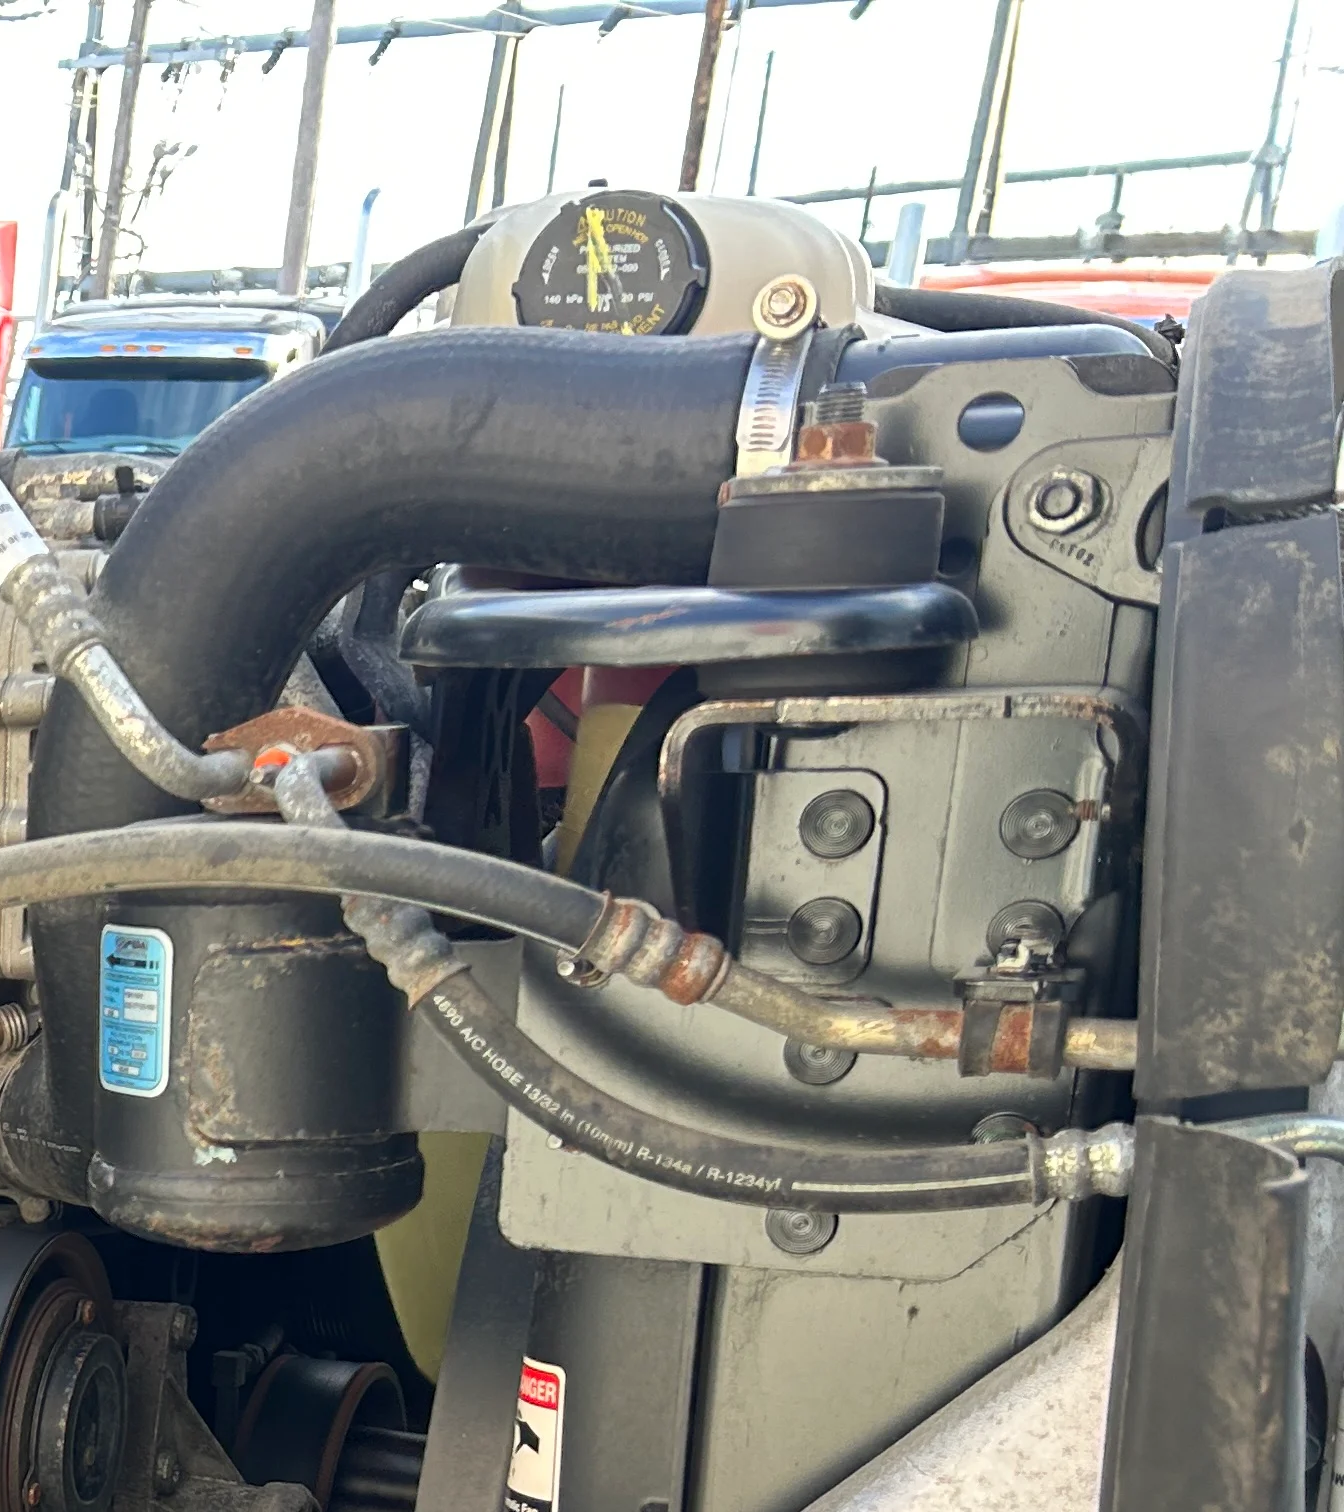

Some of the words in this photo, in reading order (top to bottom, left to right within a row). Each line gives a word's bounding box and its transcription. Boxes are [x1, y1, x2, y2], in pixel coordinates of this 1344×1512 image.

[543, 294, 562, 305] 140
[433, 993, 465, 1028] 4890
[459, 1026, 488, 1053] A/C
[482, 1046, 526, 1088] HOSE
[521, 1083, 562, 1117] 13/32
[559, 1107, 577, 1126] in
[575, 1119, 635, 1156] (10mm)
[635, 1145, 693, 1176] R-134a
[706, 1165, 783, 1194] R-1234yf
